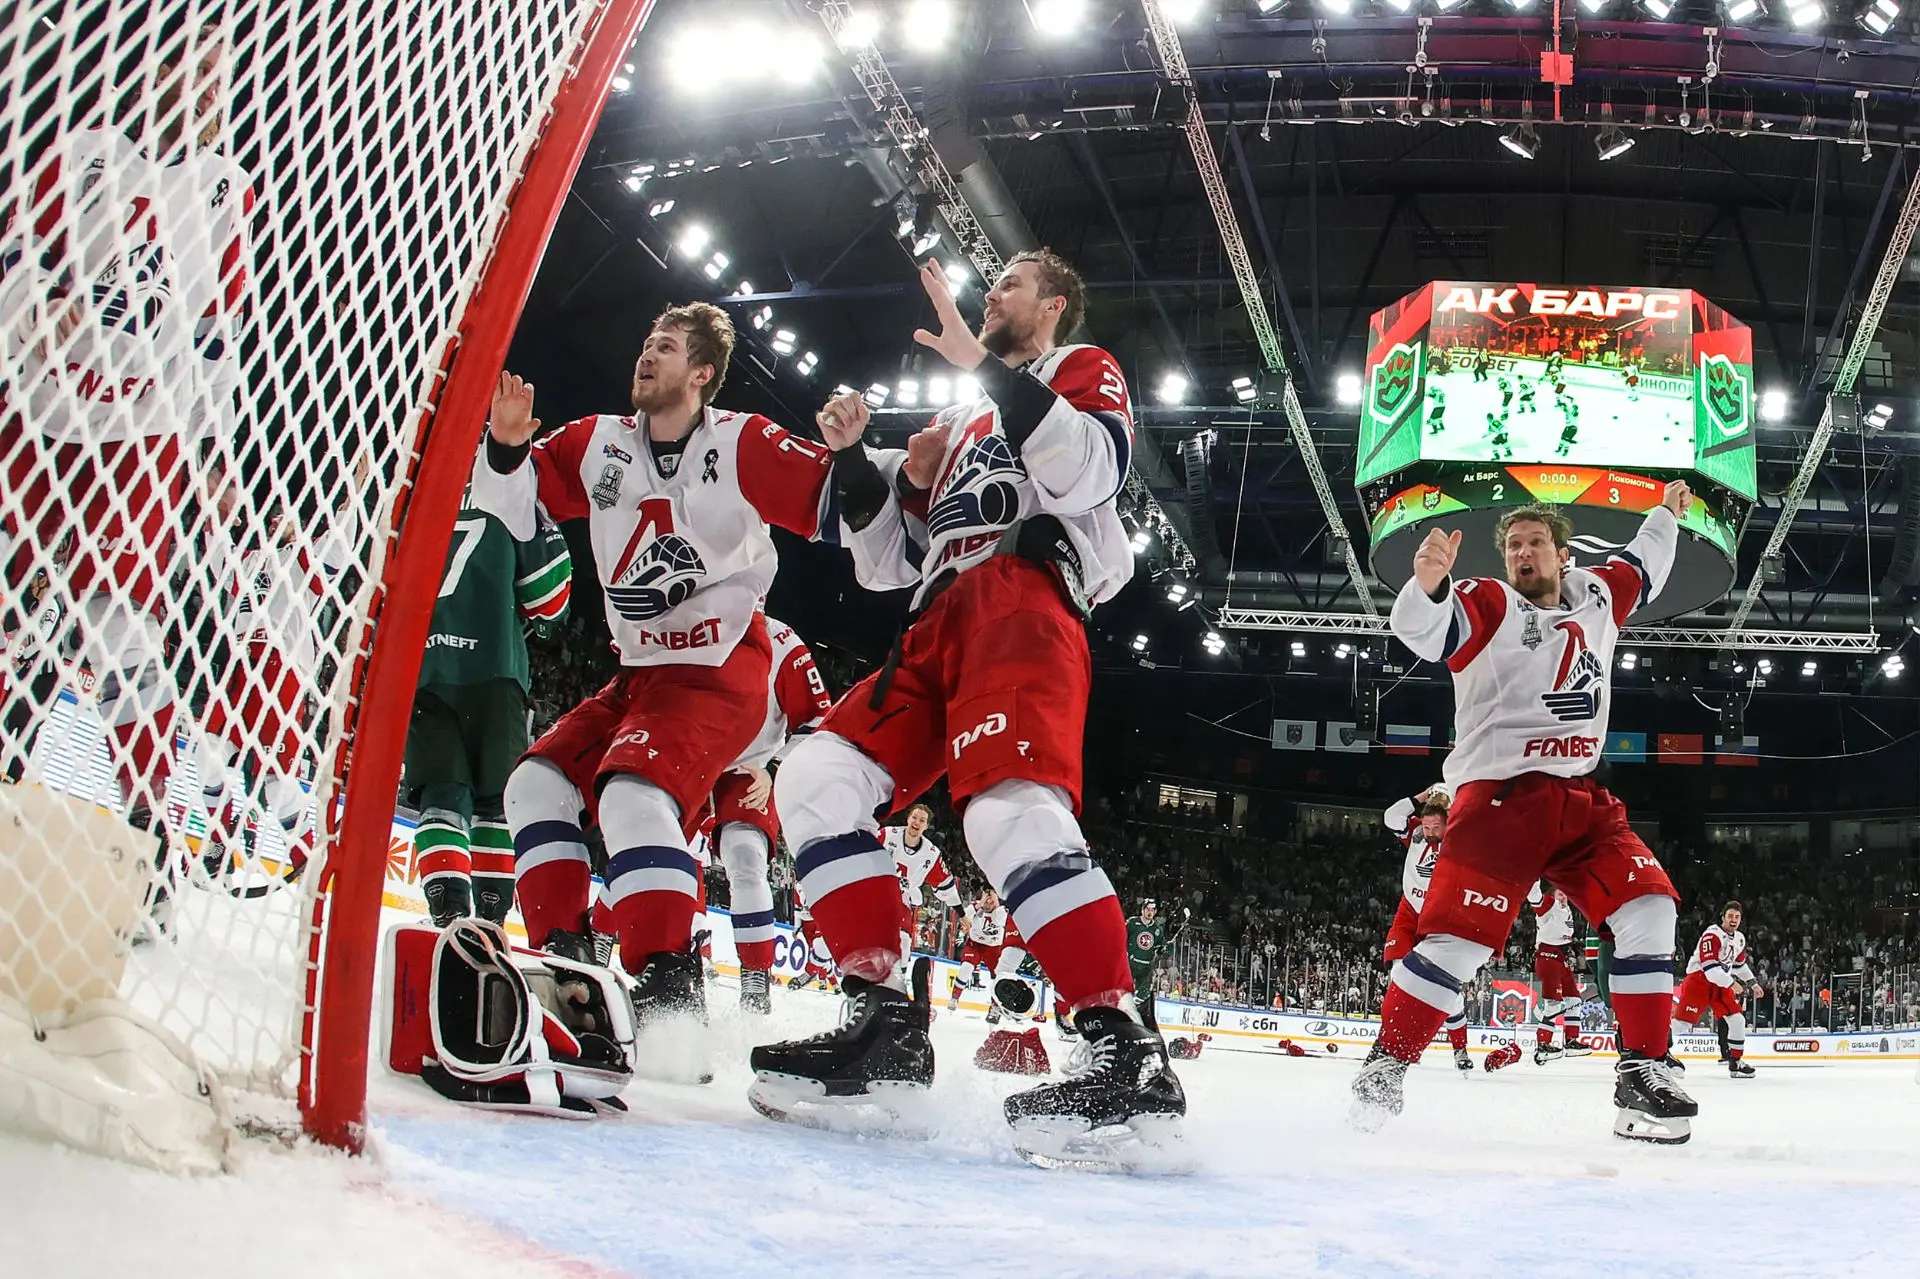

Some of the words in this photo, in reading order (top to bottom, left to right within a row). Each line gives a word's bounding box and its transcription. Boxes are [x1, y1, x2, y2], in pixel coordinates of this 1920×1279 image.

[1436, 287, 1519, 314] АК
[1529, 289, 1681, 319] БАРС
[1463, 474, 1475, 483] Ак
[1476, 471, 1499, 482] Барс
[1539, 473, 1577, 485] 0:00.0
[1608, 473, 1656, 490] Локомотив
[1491, 484, 1504, 501] 2
[1608, 487, 1620, 504] 3
[1252, 1018, 1278, 1031] сбп
[1342, 1026, 1378, 1038] LADA
[1677, 1038, 1717, 1046] ATRIBUTI
[1775, 1042, 1811, 1051] WINLINE
